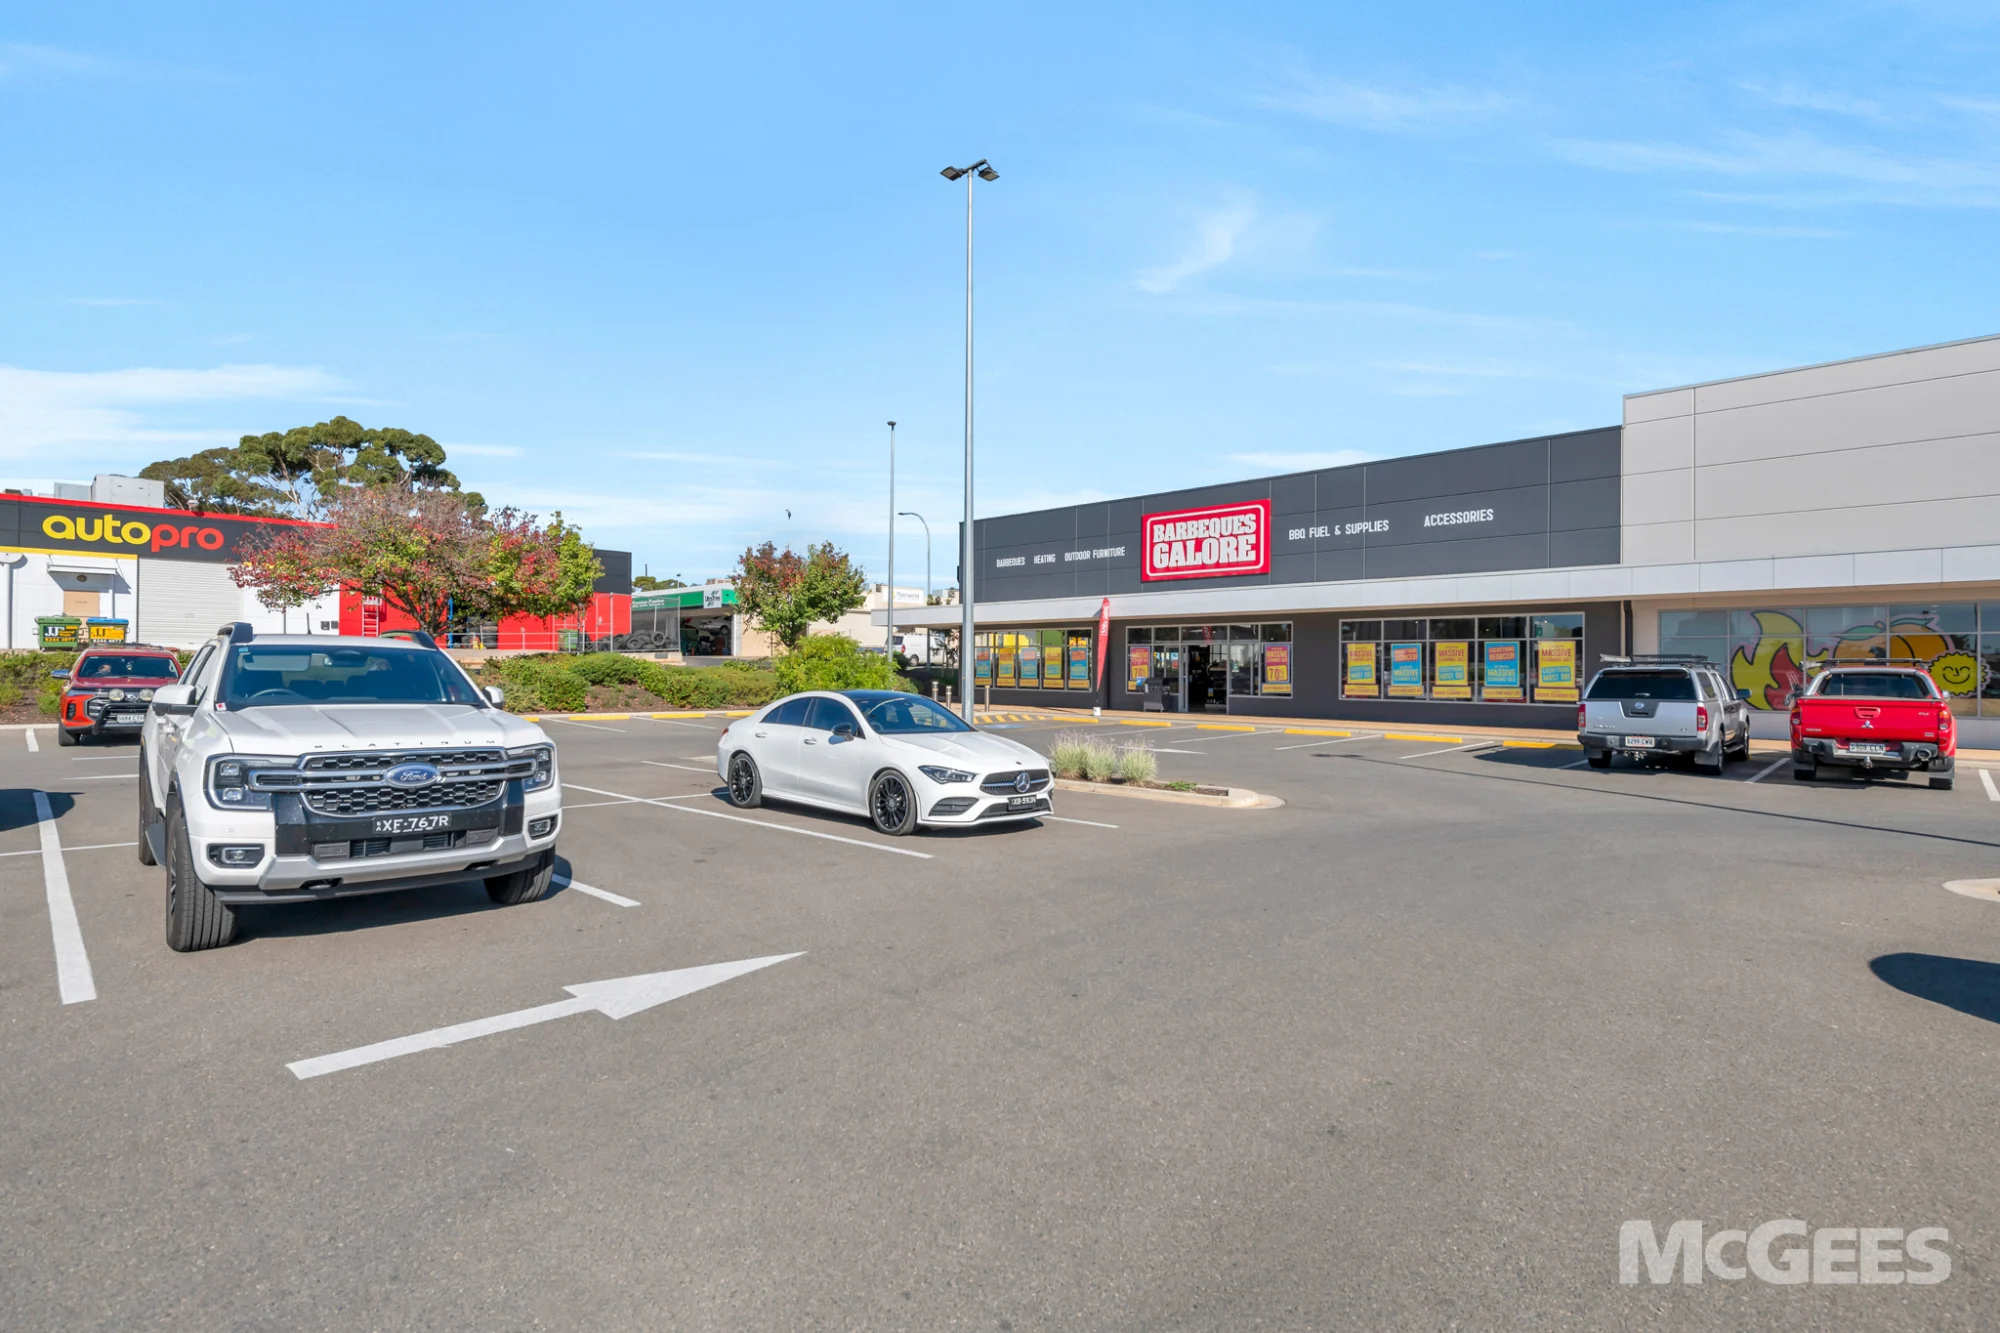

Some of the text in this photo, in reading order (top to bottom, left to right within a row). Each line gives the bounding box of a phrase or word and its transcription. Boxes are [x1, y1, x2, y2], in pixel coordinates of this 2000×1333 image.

[1424, 509, 1494, 527] ACCESSORIES
[42, 514, 224, 552] autopro
[1153, 514, 1257, 543] BARBEQUES
[1288, 520, 1389, 540] BBQ FUEL & SUPPLIES
[1064, 546, 1126, 562] OUTDOOR FURNITURE
[1153, 534, 1256, 568] GALORE
[996, 557, 1025, 568] BARBEQUES
[1033, 554, 1056, 564] HEATING
[1439, 649, 1465, 657] MASSIVE
[1541, 649, 1572, 657] MASSIVE
[1487, 668, 1516, 677] MASSIVE
[400, 771, 430, 781] Ford
